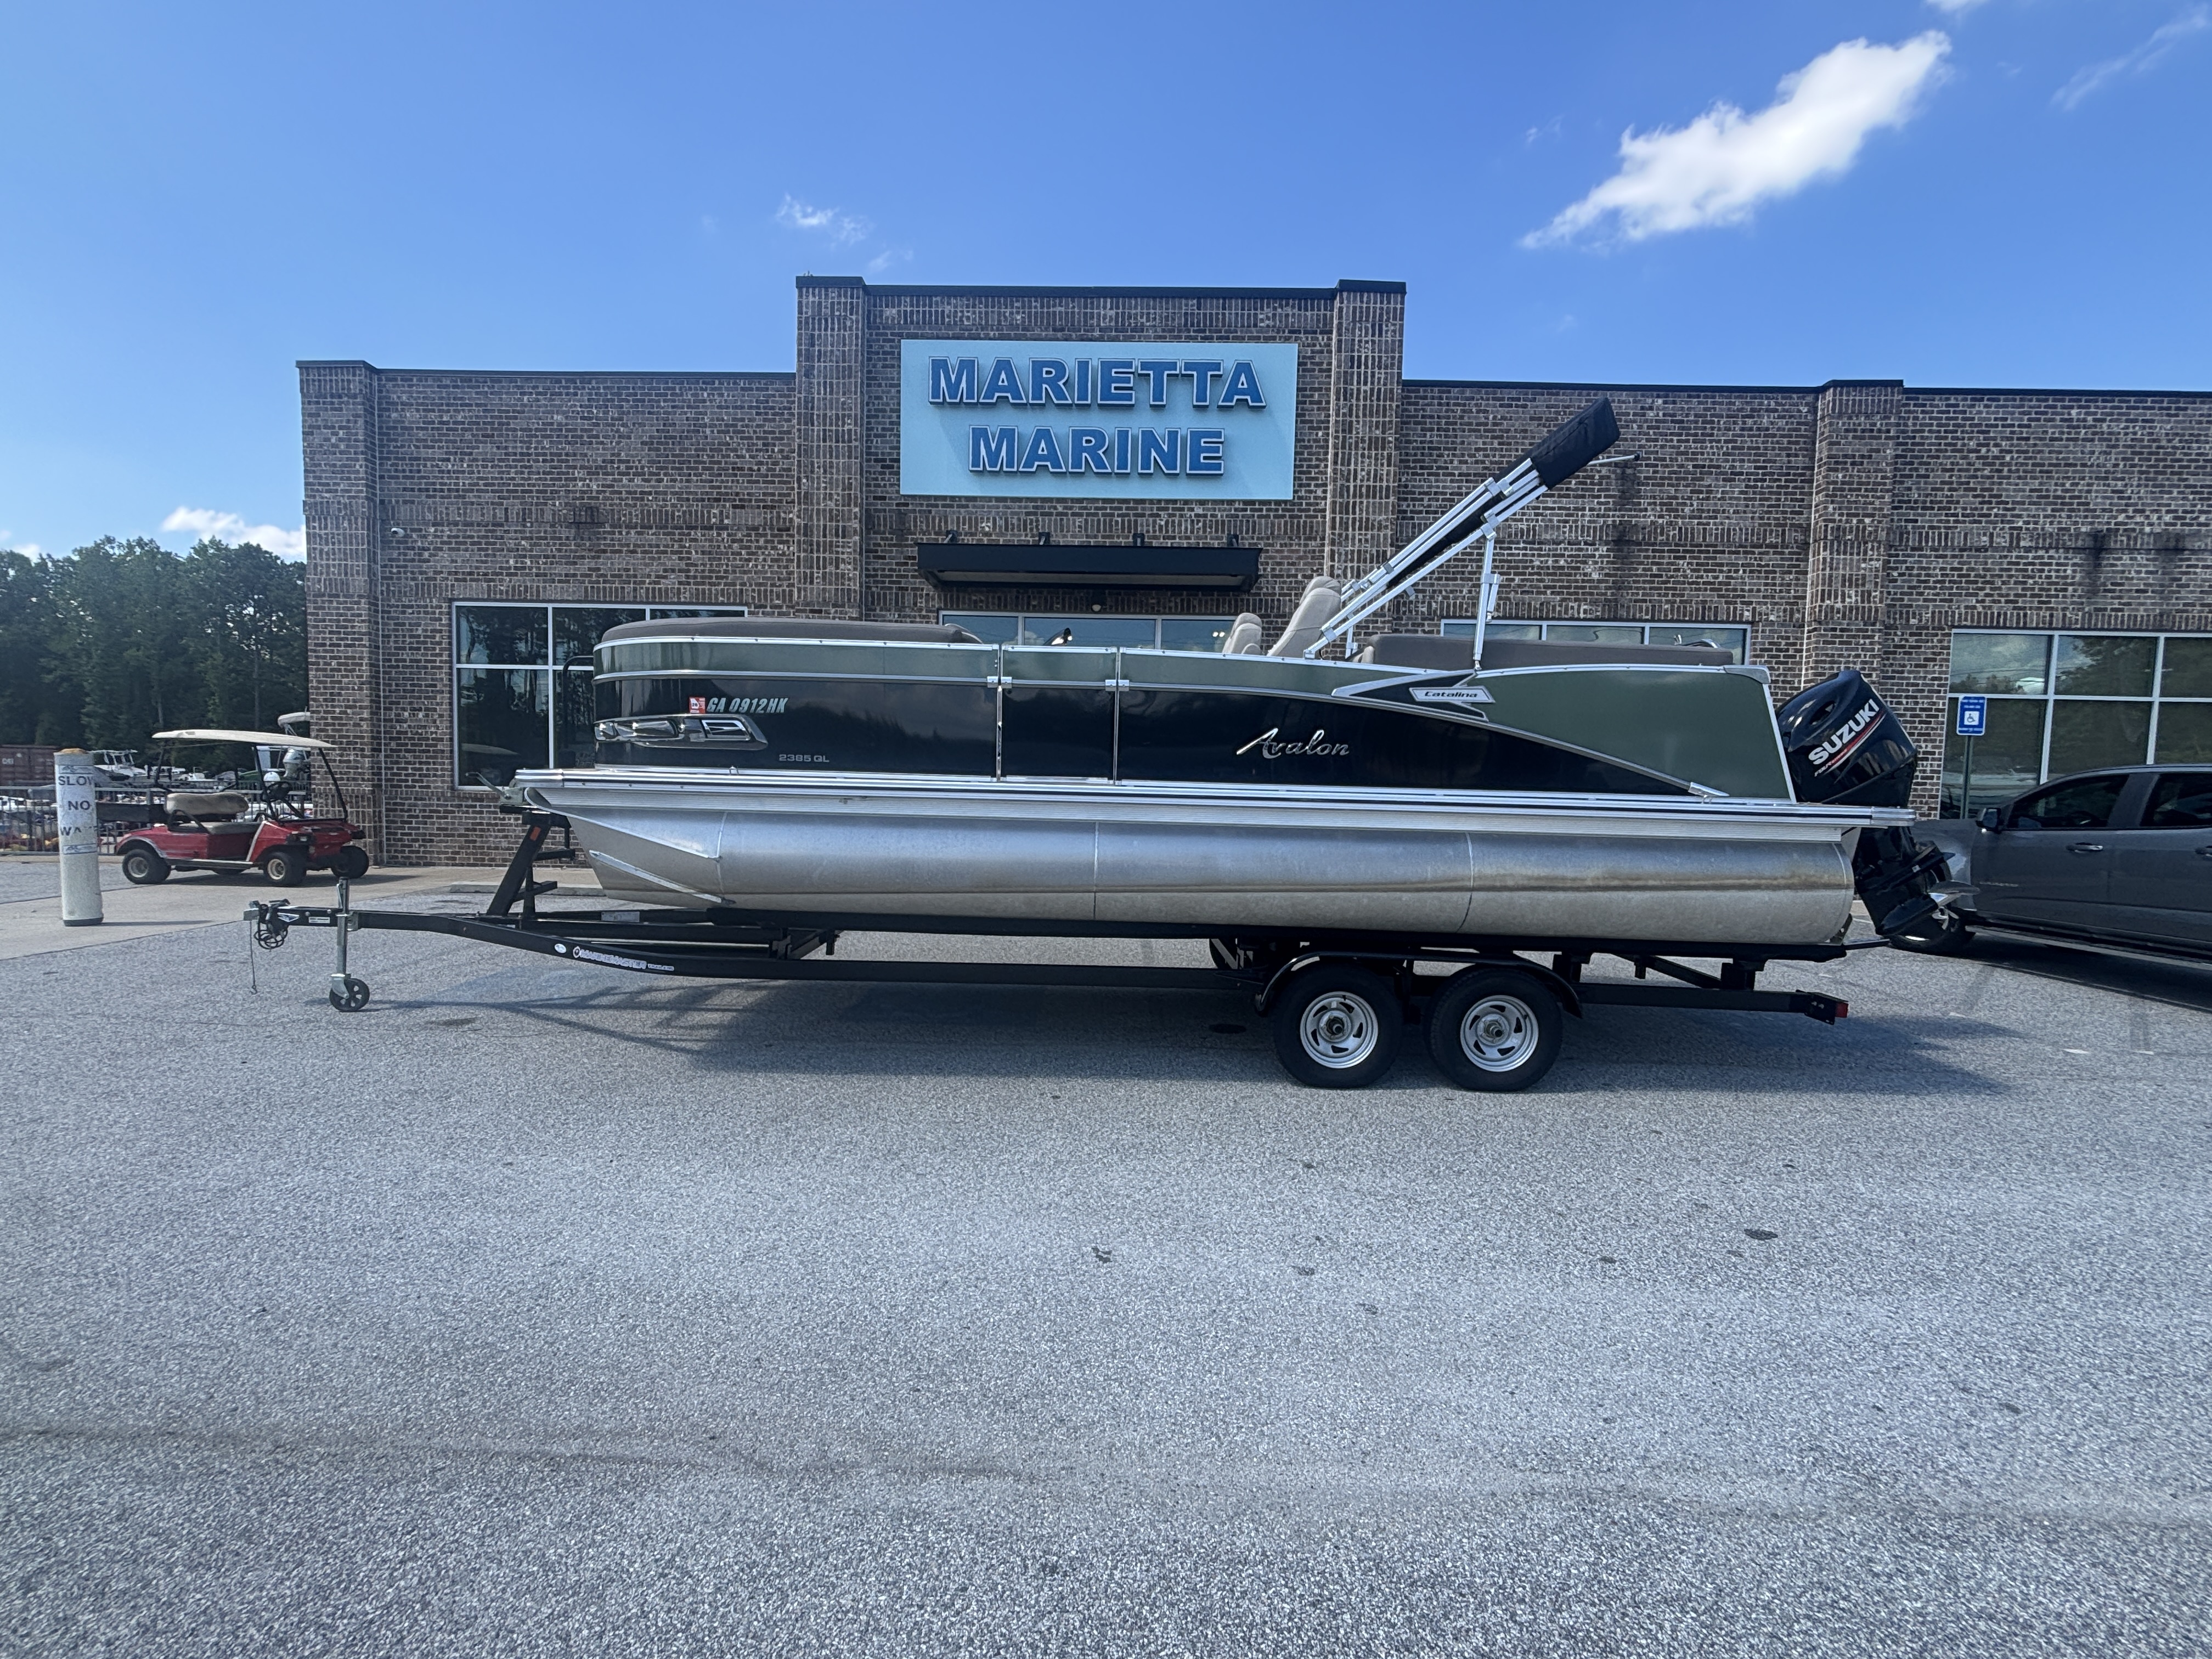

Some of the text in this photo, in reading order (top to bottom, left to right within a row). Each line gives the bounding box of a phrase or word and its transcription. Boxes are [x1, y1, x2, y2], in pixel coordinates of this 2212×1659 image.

[928, 357, 1267, 408] MARIETTA
[968, 425, 1225, 475] MARINE
[707, 697, 788, 713] GA 0912HK
[1237, 727, 1349, 759] Avalon
[1808, 698, 1880, 765] SUZUKI
[779, 754, 811, 762] 2385
[68, 800, 90, 810] NO
